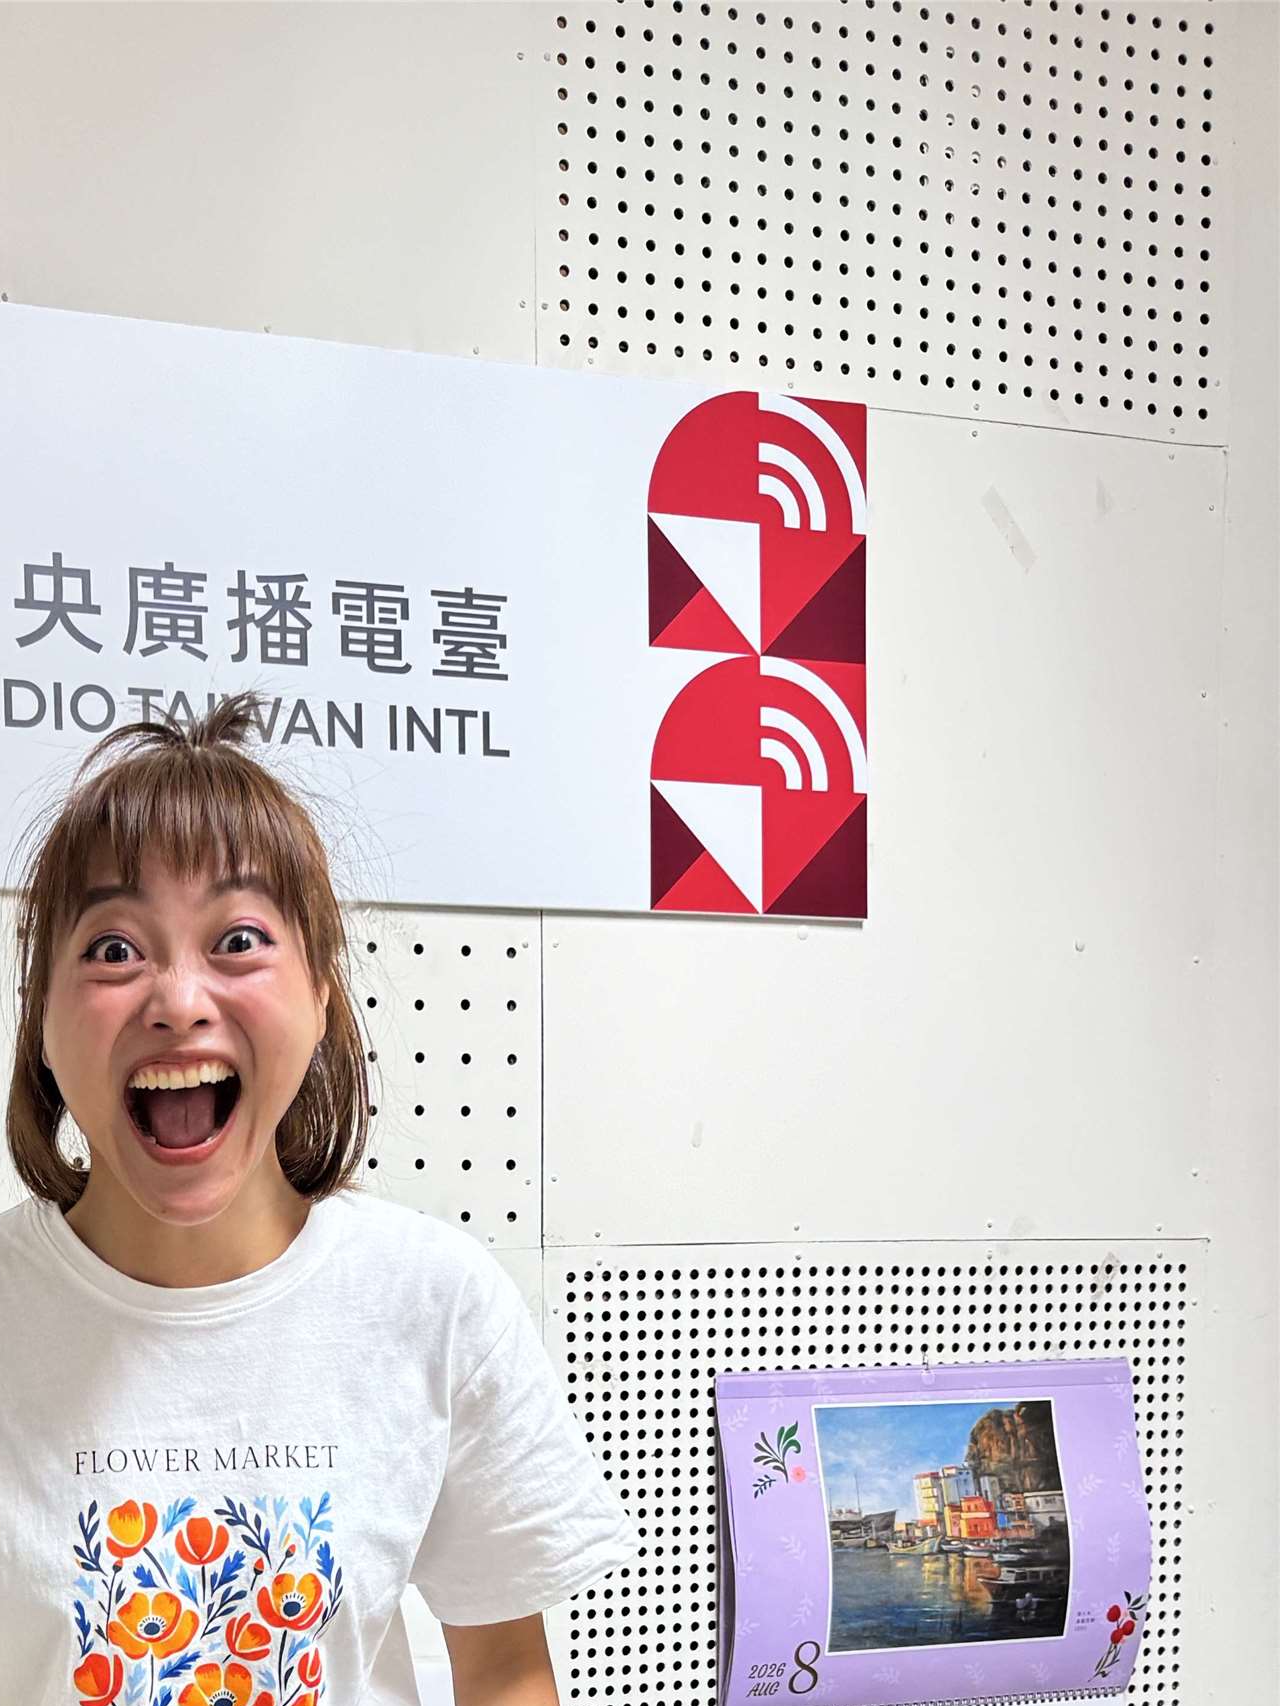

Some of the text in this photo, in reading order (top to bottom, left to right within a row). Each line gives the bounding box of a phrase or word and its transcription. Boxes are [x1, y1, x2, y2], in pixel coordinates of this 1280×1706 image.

[389, 705, 510, 757] INTL
[76, 1445, 339, 1475] FLOWER MARKET
[748, 1641, 820, 1694] 2026 8
[746, 1681, 779, 1697] AUG
